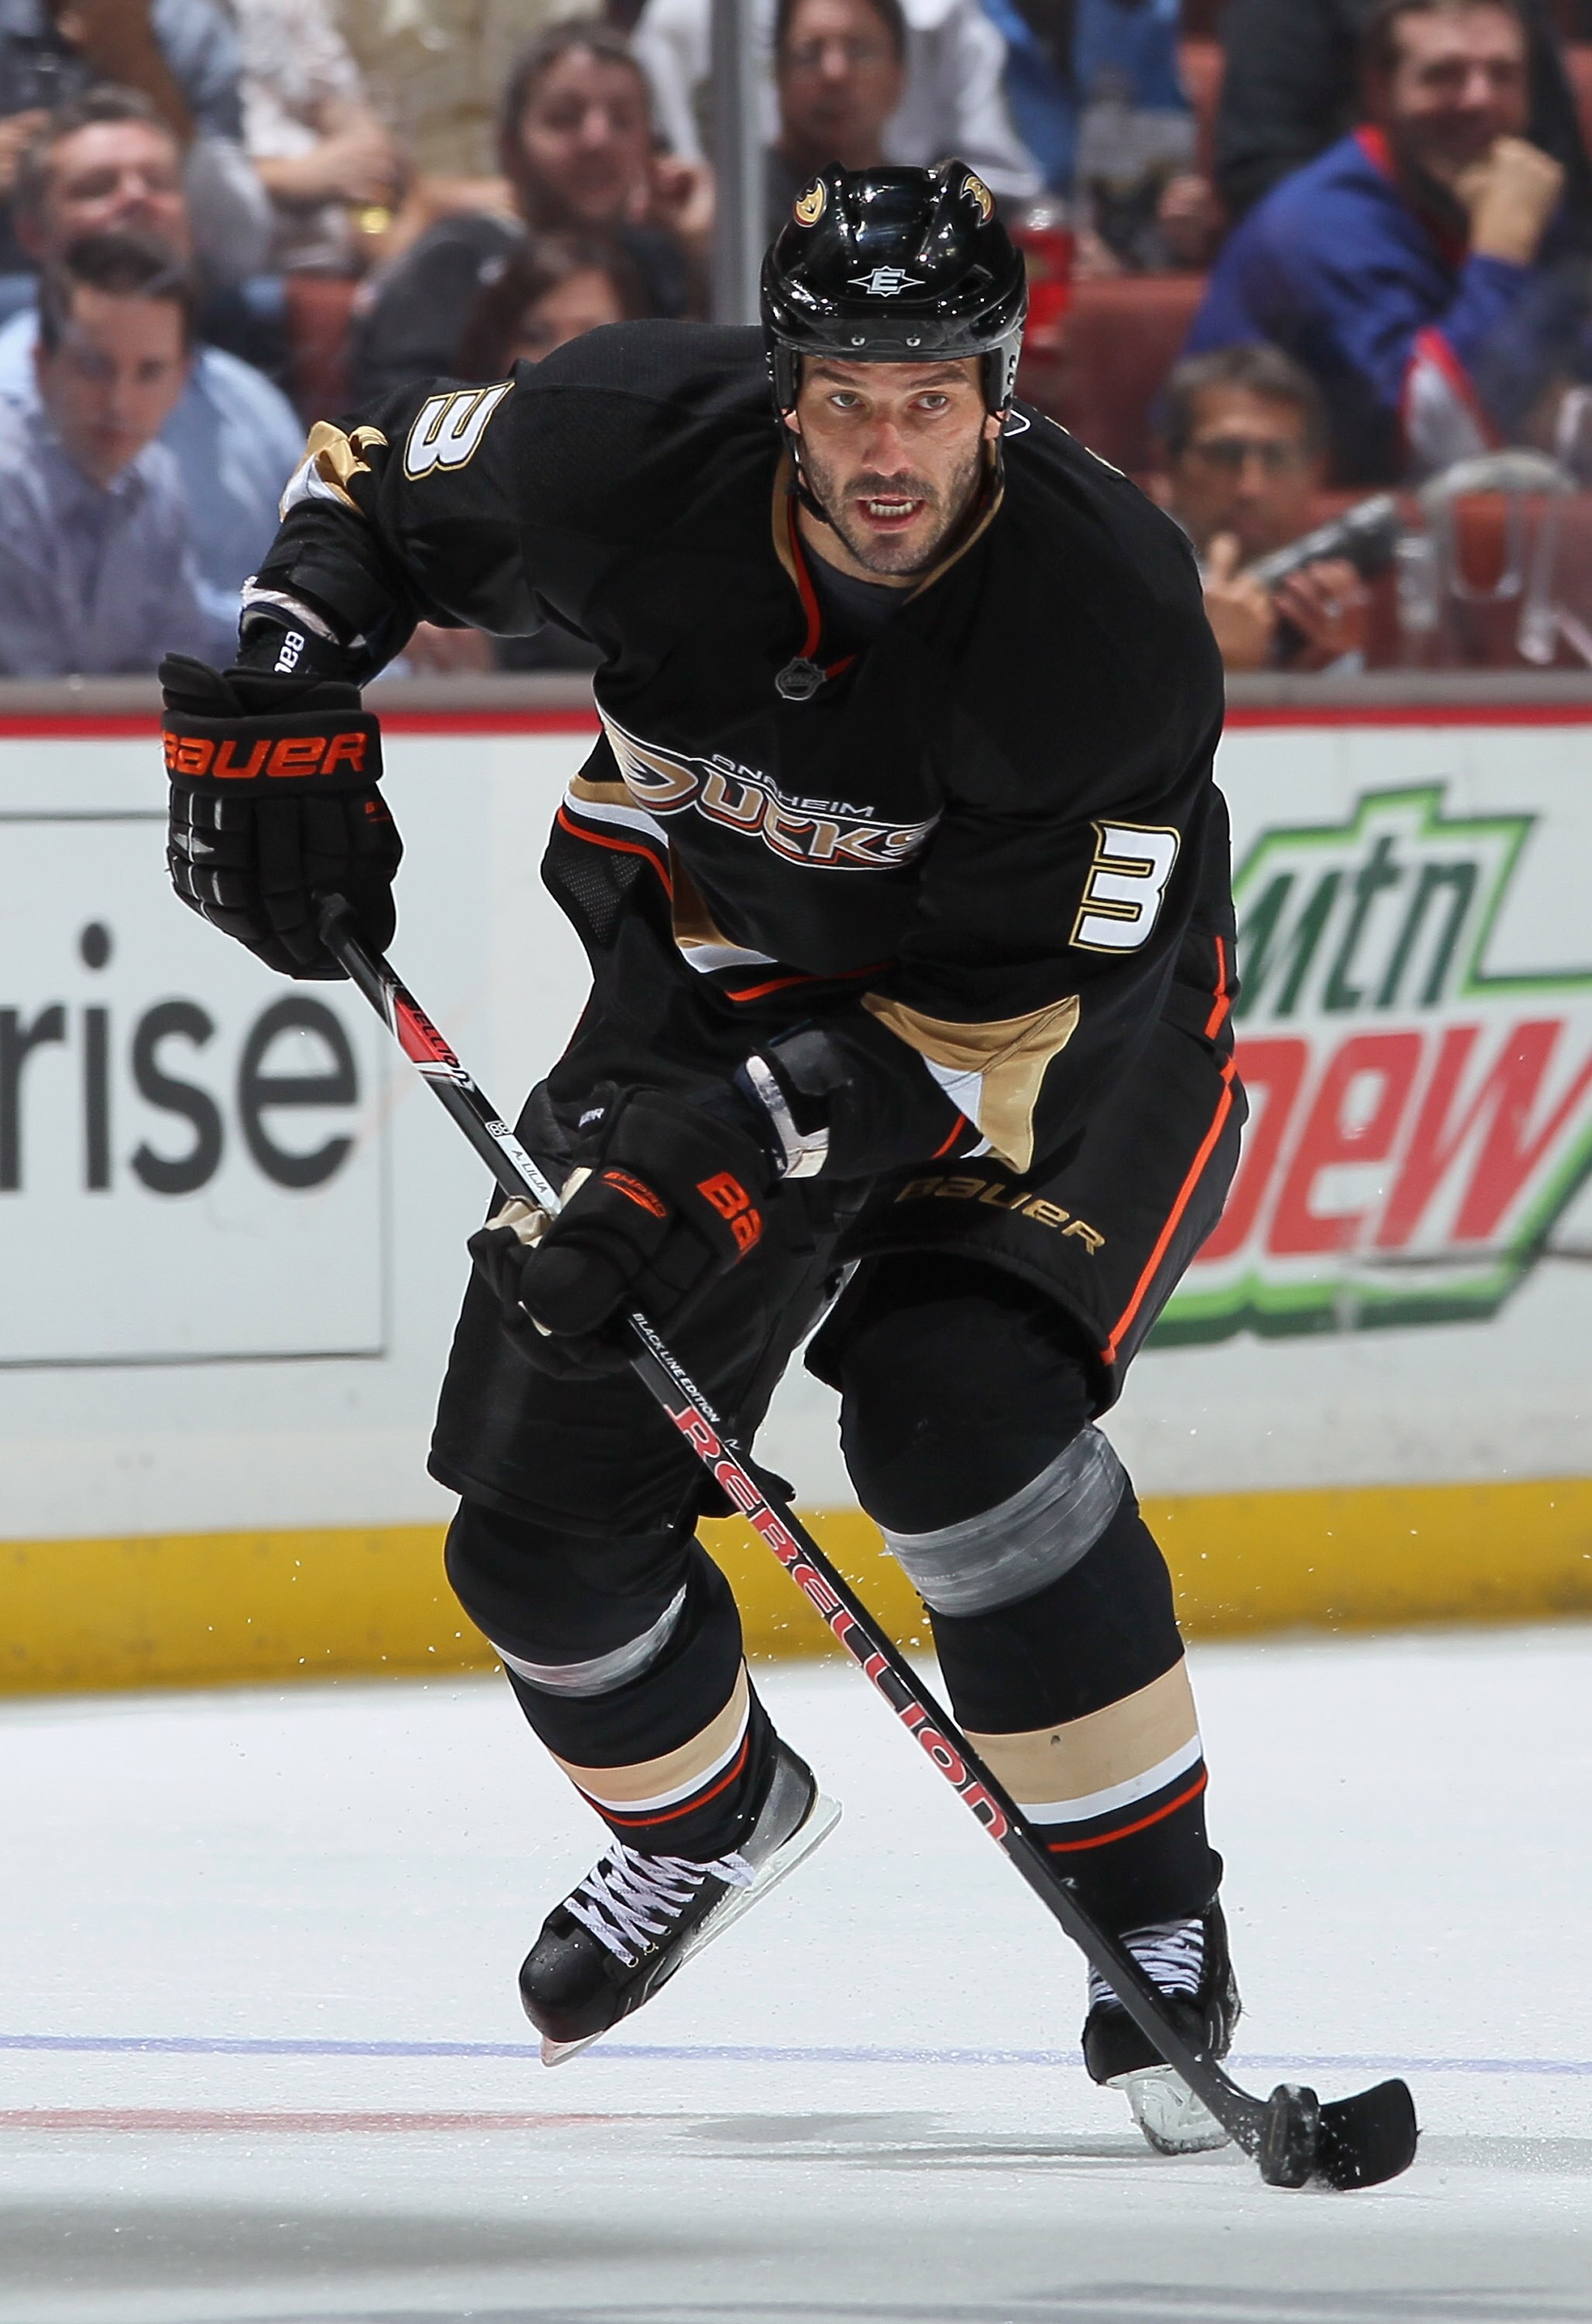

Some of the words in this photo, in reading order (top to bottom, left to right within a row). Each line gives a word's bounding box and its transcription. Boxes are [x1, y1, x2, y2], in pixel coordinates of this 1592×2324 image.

[870, 271, 902, 292] E
[404, 380, 515, 481] 3
[712, 754, 875, 817] ANAHEIM
[1068, 820, 1181, 954] 3
[0, 920, 359, 1194] rise
[522, 1163, 548, 1193] LILJA
[632, 1313, 665, 1350] BLACK
[660, 1351, 686, 1377] LINE
[679, 1378, 720, 1423] EDITION
